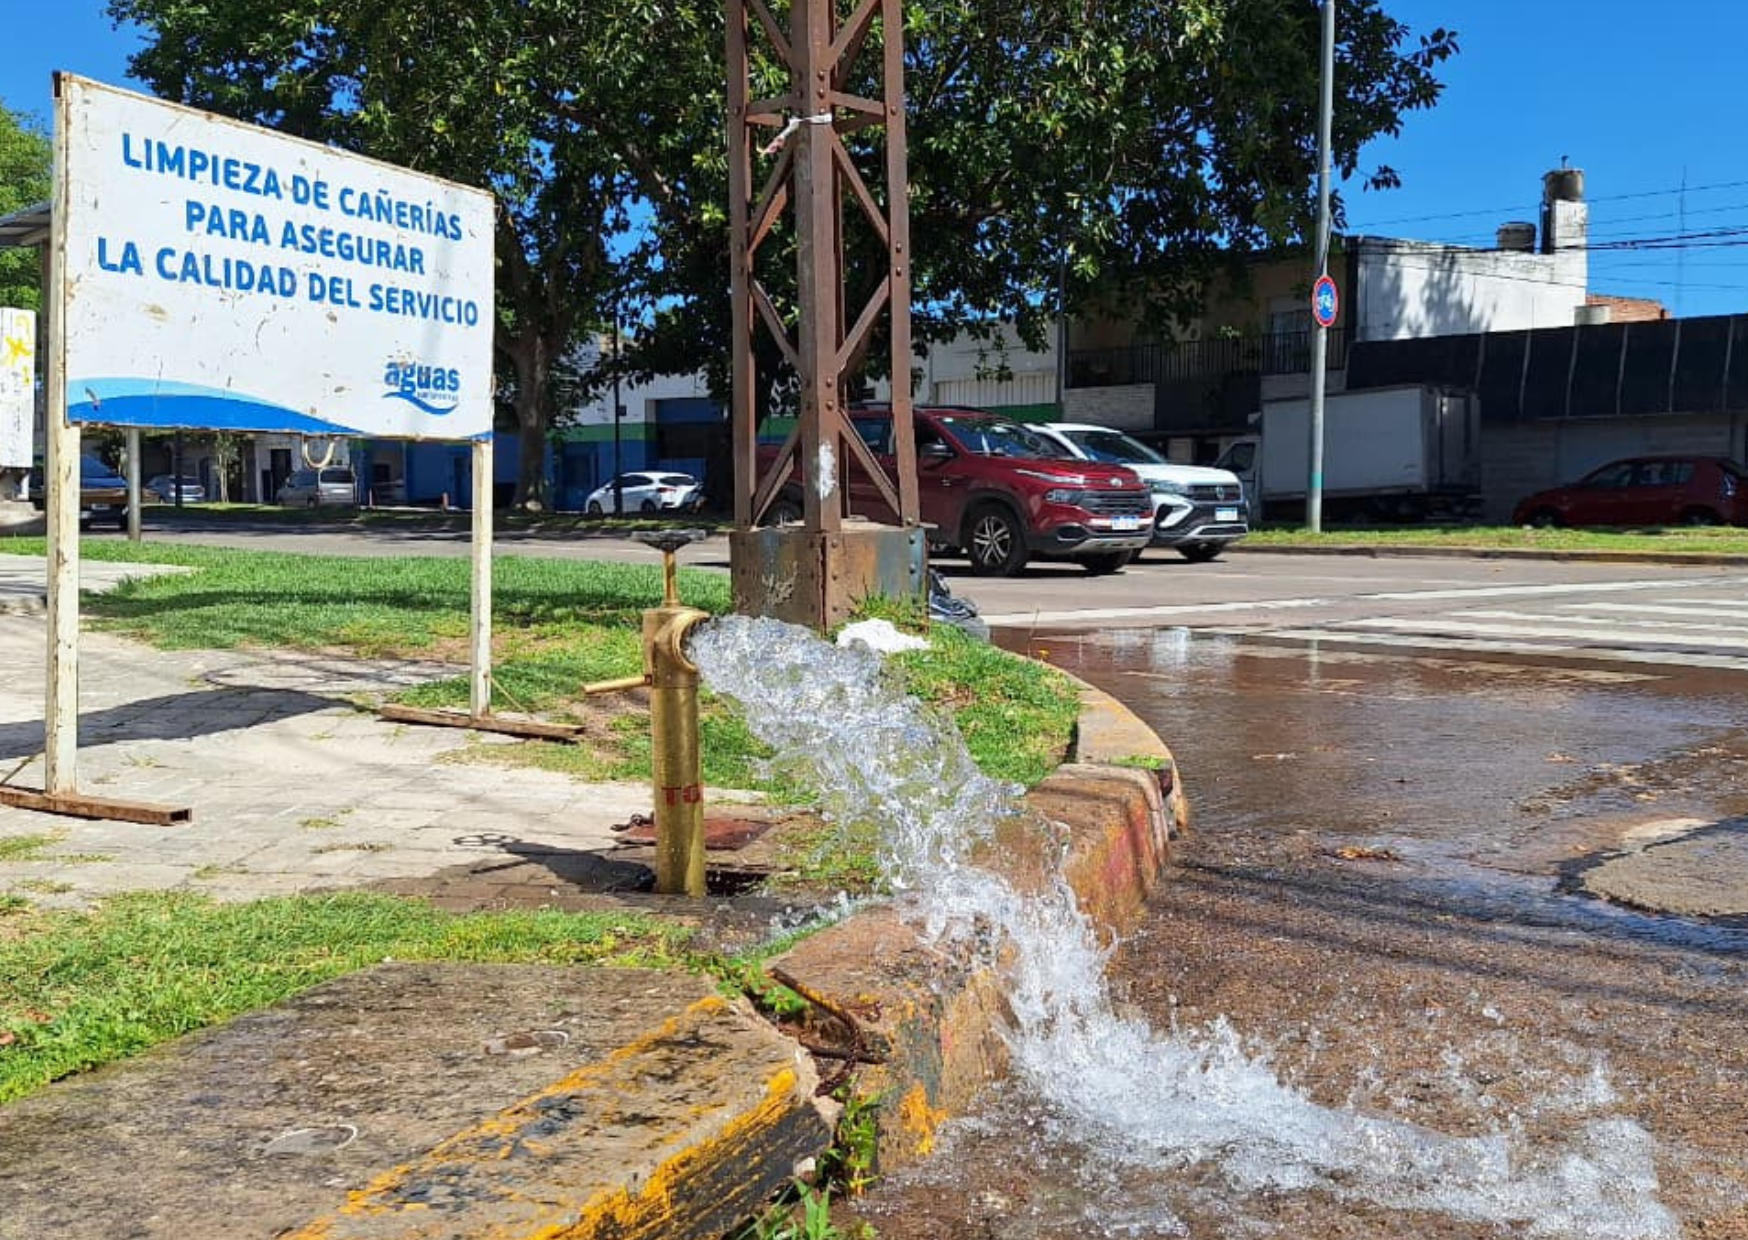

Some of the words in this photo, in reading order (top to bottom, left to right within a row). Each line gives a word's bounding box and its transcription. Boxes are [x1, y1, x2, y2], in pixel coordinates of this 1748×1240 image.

[122, 133, 282, 200] LIMPIEZA
[292, 174, 330, 211] DE
[339, 187, 462, 241] CAÑERÍAS
[186, 199, 271, 246] PARA
[281, 220, 425, 275] ASEGURAR
[98, 236, 143, 276] LA
[156, 247, 297, 298] CALIDAD
[309, 272, 361, 308] DEL
[369, 283, 478, 327] SERVICIO
[384, 361, 460, 393] aguas
